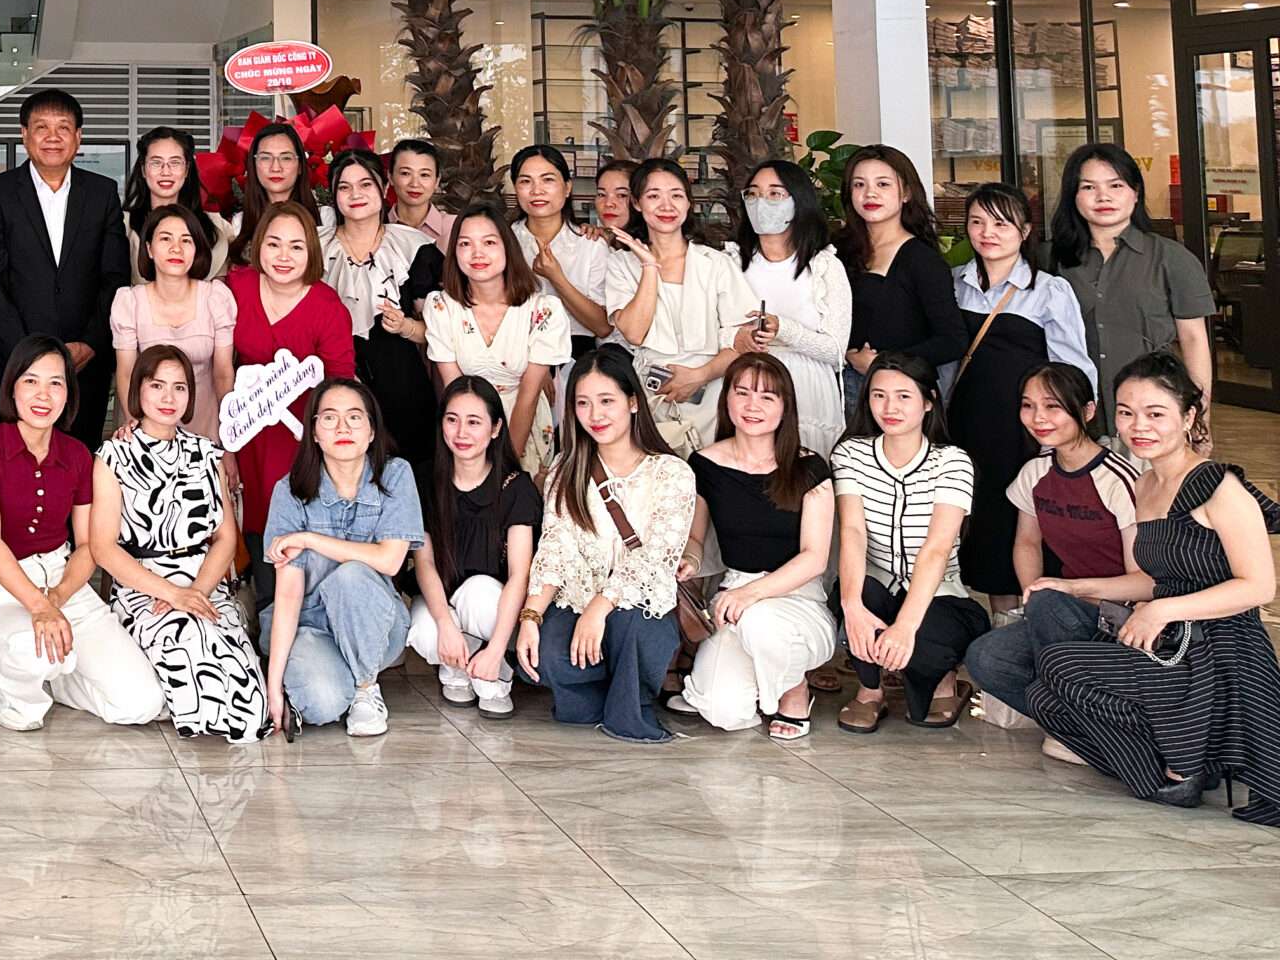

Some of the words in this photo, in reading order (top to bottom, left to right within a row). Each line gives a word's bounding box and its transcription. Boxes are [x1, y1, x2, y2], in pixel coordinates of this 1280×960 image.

[237, 56, 252, 66] BAN
[253, 54, 271, 65] GIÁM
[288, 51, 307, 62] CÔNG
[308, 51, 316, 60] TY
[234, 69, 261, 79] CHÚC
[263, 66, 293, 77] MỪNG
[295, 63, 322, 74] NGÀY
[267, 77, 291, 87] 20/10
[248, 387, 263, 401] em
[265, 356, 291, 387] mình
